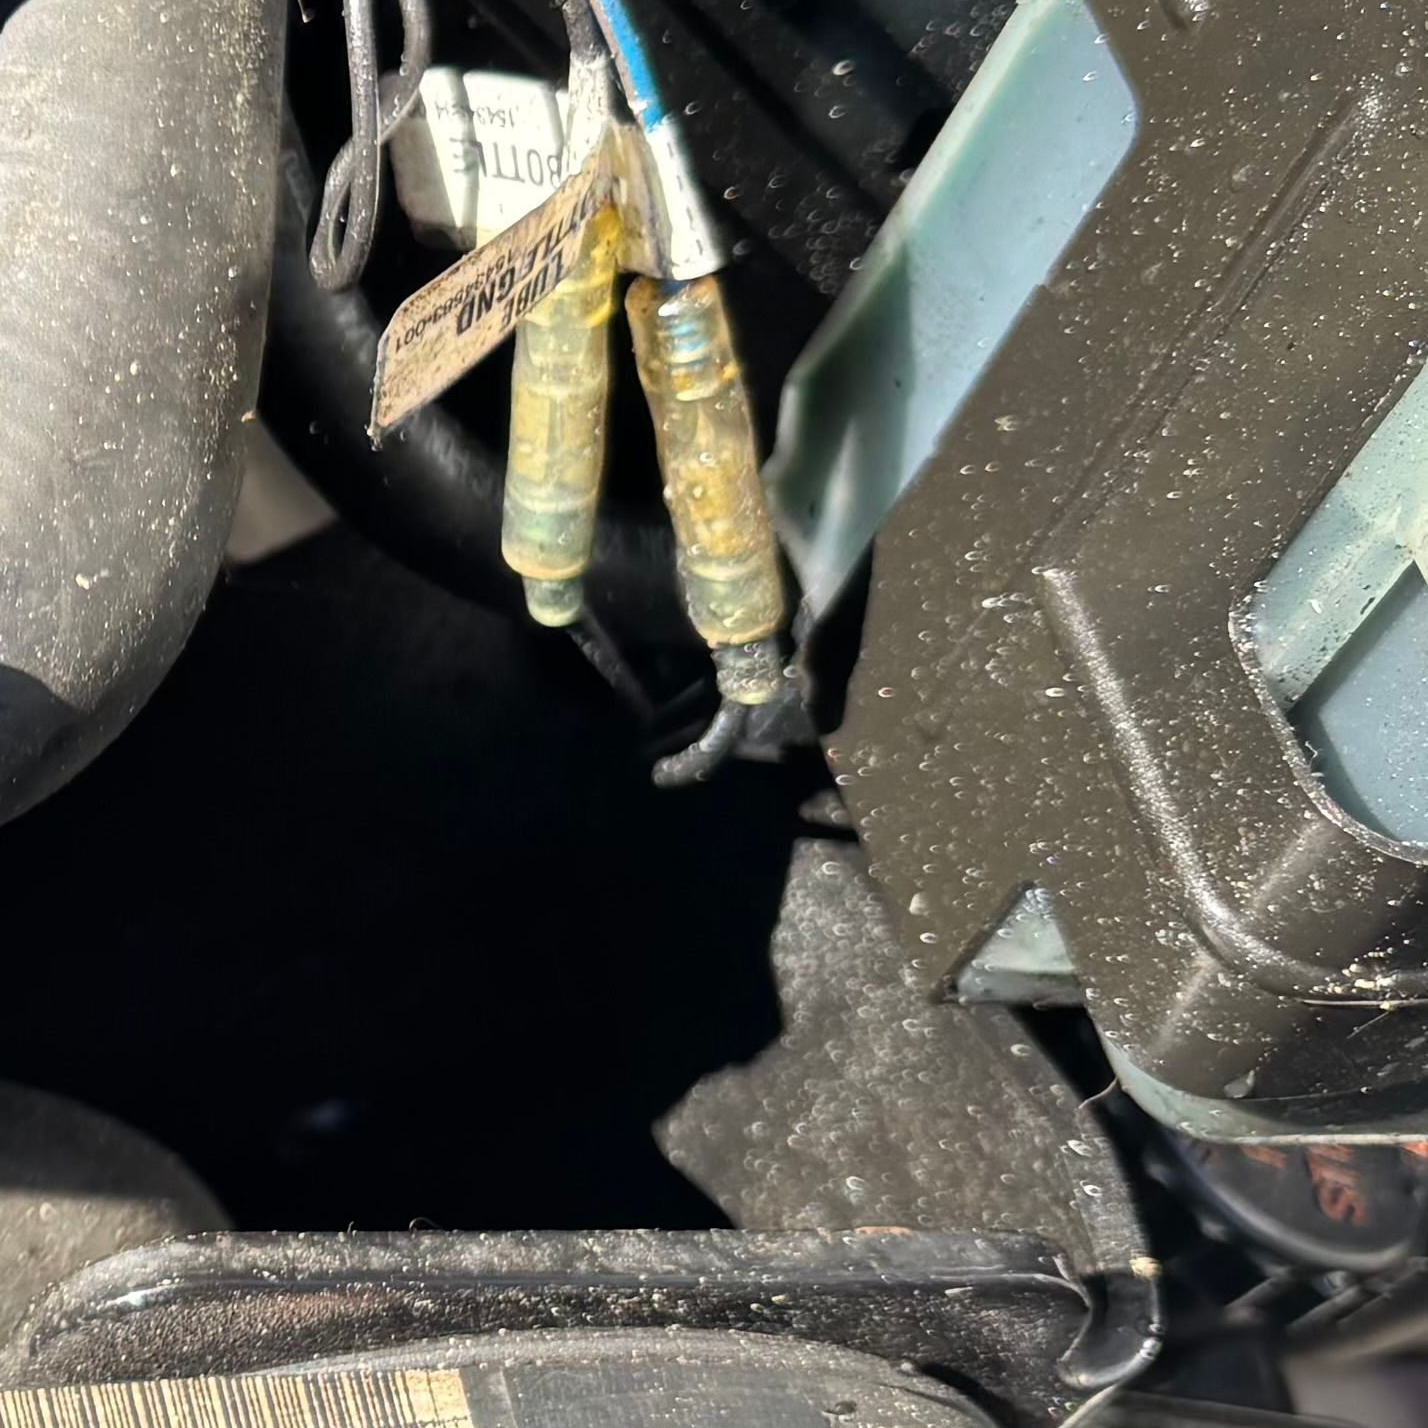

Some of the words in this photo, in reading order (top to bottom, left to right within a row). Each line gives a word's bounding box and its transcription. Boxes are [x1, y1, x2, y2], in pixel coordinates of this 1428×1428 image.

[449, 136, 564, 190] BOTTLE
[456, 266, 516, 336] GND
[501, 246, 565, 331] LUBE
